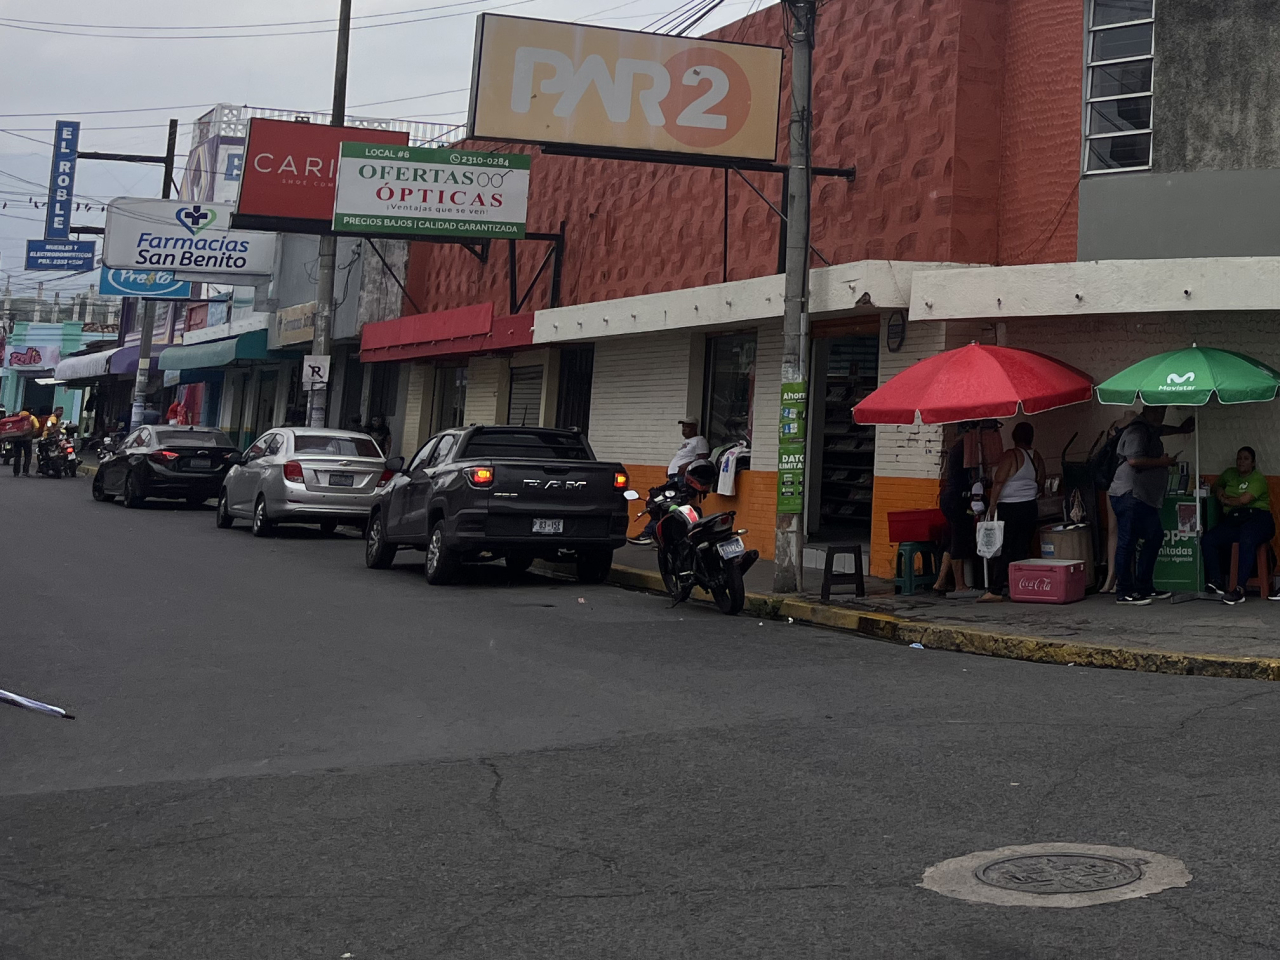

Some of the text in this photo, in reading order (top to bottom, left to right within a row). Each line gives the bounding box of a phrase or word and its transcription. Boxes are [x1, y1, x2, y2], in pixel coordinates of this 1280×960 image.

[60, 127, 73, 153] EL
[365, 148, 410, 159] LOCAL #6
[461, 155, 510, 167] 2310-0284
[253, 153, 335, 178] CARI
[358, 164, 474, 186] OFERTAS
[53, 161, 72, 229] ROBLE
[376, 182, 504, 208] ÓPTICAS
[435, 207, 453, 215] que
[343, 216, 518, 233] PRECIOS BAJOS CALIDAD GARANTIZADA
[136, 232, 250, 253] Farmacias
[135, 249, 247, 269] San Benito
